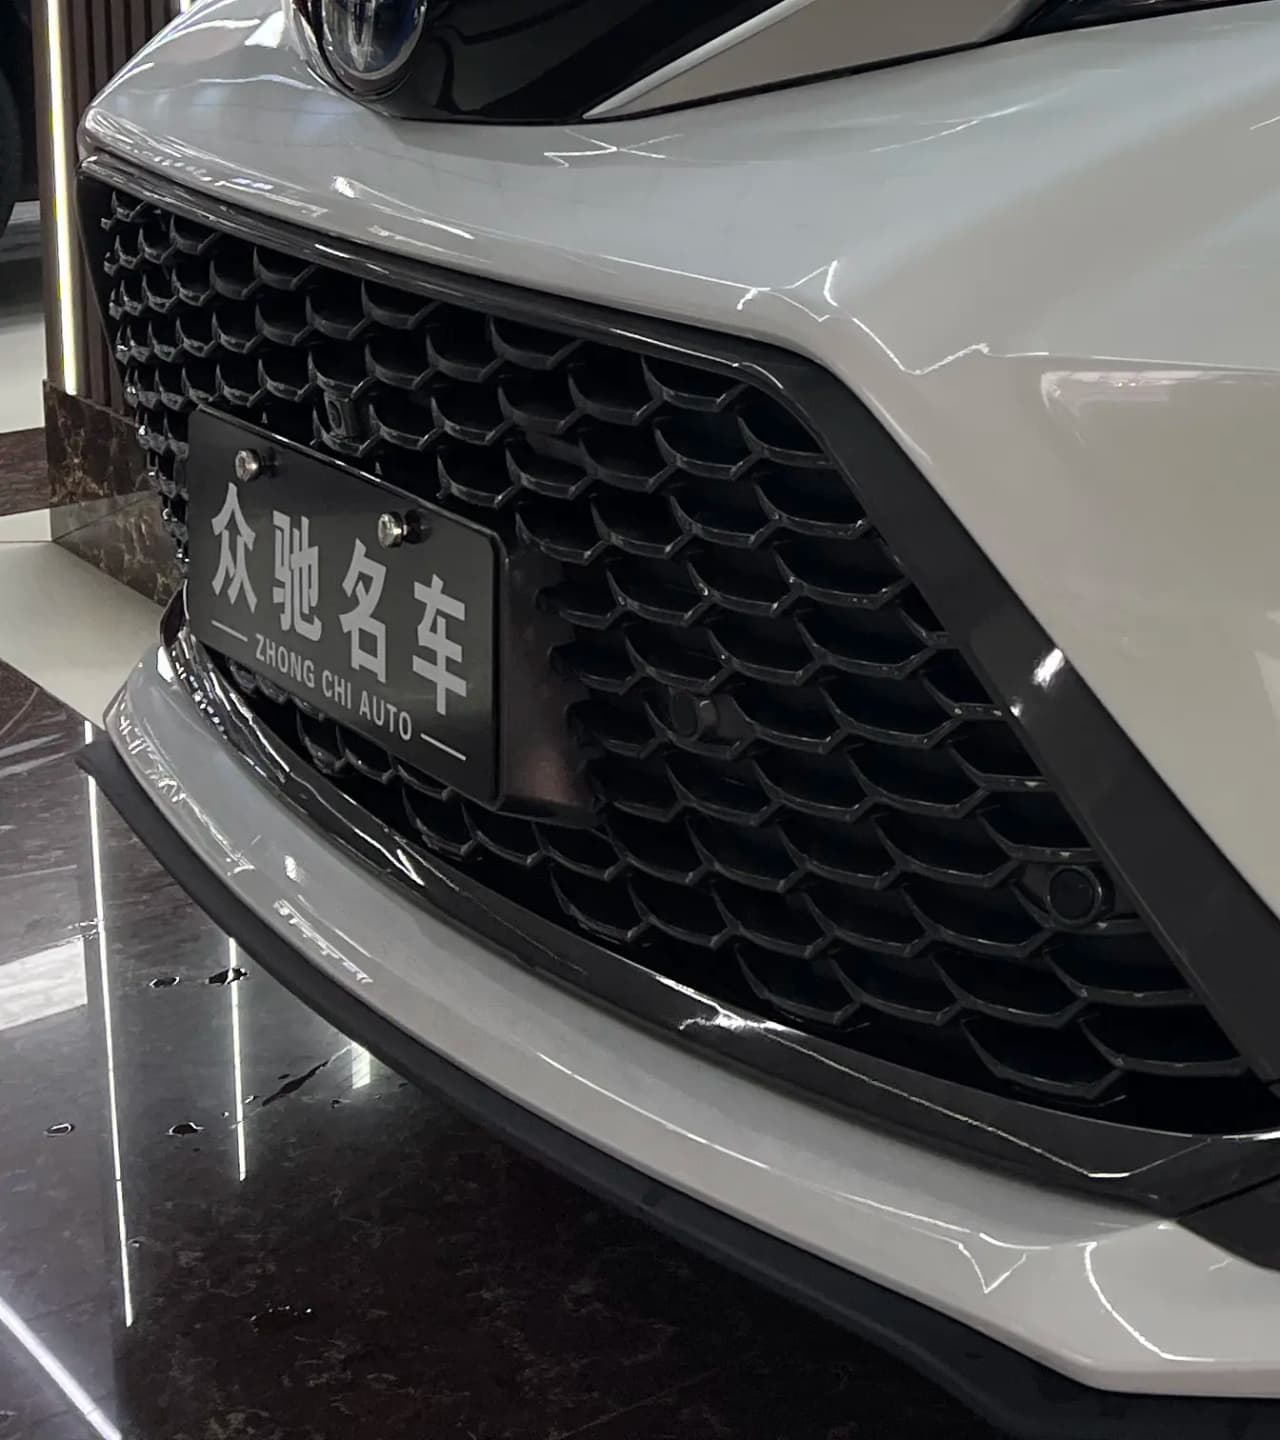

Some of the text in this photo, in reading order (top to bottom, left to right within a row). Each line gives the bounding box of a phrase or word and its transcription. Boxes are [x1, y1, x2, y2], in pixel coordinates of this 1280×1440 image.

[211, 482, 468, 716] 众驰名车
[255, 633, 413, 742] ZHONG CHI AUTO
